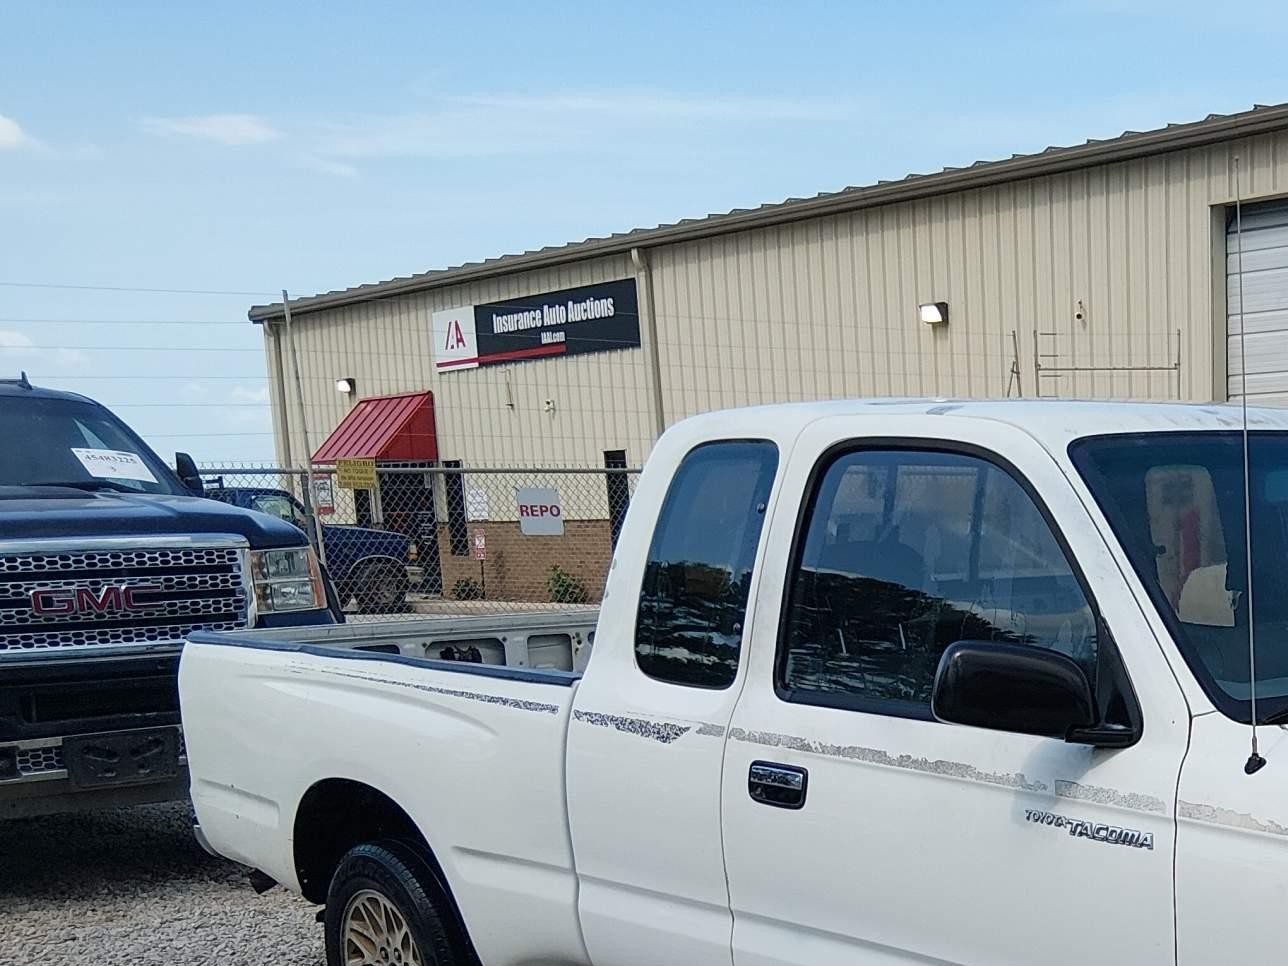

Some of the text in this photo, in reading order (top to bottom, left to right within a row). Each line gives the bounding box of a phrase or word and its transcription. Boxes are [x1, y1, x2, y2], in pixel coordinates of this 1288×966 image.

[492, 297, 615, 334] Insurance Auto Auctions
[519, 504, 561, 517] REPO
[30, 584, 165, 615] GMC
[1067, 818, 1154, 850] TACOMA
